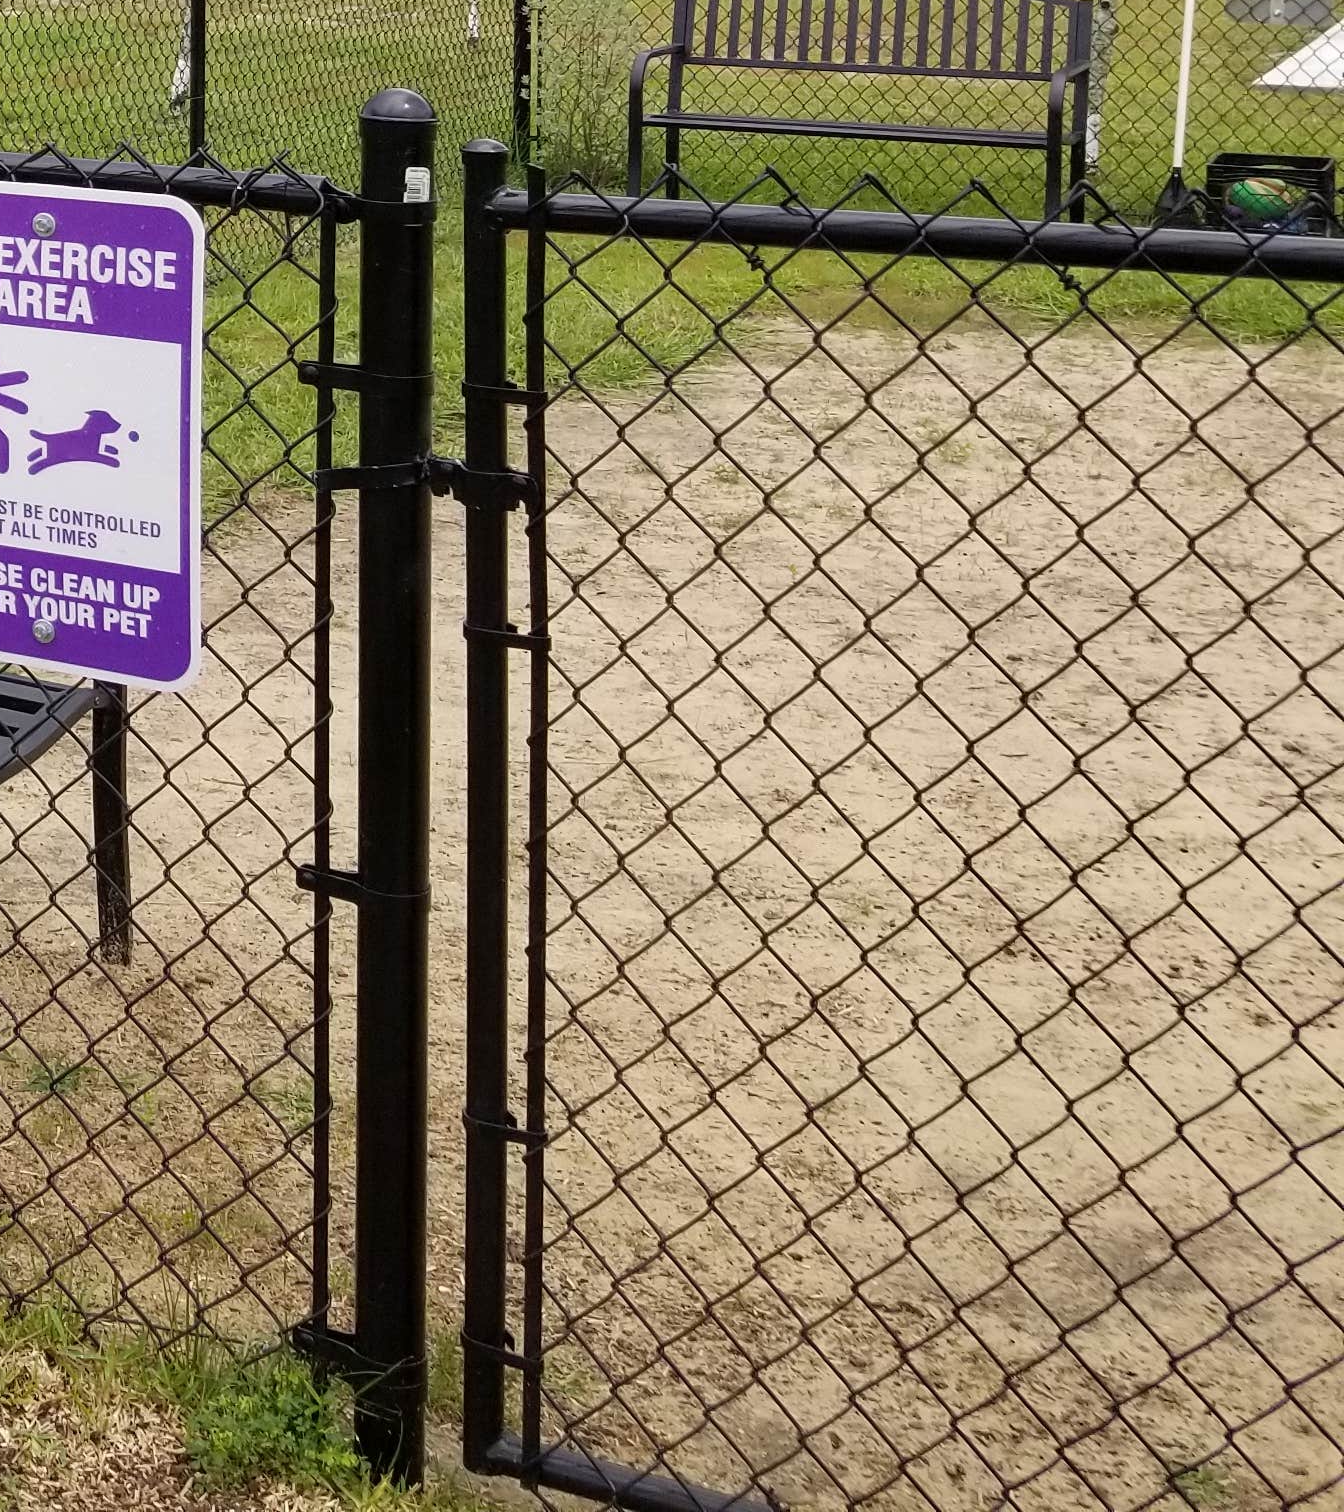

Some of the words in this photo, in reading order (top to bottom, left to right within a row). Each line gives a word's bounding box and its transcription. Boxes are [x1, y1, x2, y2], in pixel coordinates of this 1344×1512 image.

[11, 520, 40, 540] ALL
[48, 525, 97, 549] TIMES
[23, 502, 43, 521] BE
[49, 507, 161, 538] CONTROLLED
[30, 567, 115, 604] CLEAN
[122, 582, 161, 611] UP
[22, 595, 95, 628] YOUR
[103, 609, 151, 638] PET
